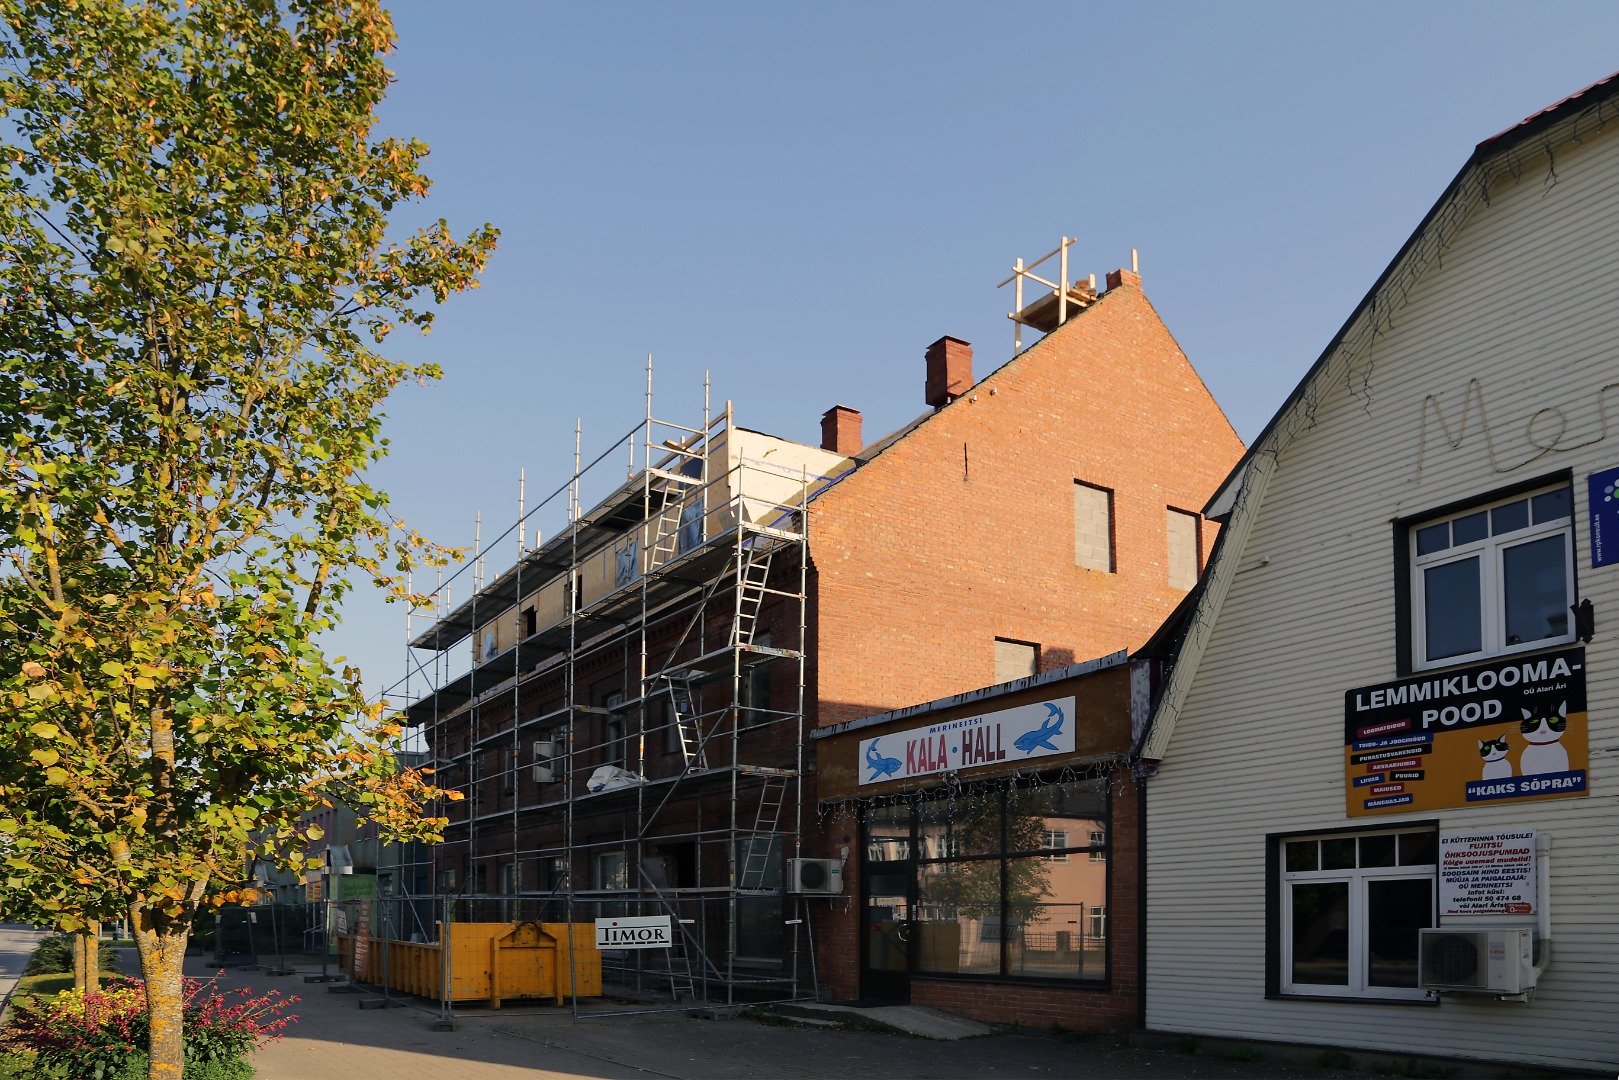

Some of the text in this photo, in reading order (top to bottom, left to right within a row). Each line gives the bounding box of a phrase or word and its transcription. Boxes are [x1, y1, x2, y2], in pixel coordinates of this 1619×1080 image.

[1356, 657, 1582, 712] LEMMIKLOOMA-
[1422, 699, 1503, 729] POOD
[929, 718, 983, 733] MERINEITSI
[1364, 722, 1405, 734] LOOMATOIDUD
[1389, 736, 1426, 745] JOOGINÕUD
[907, 724, 1005, 774] KALA HALL
[1360, 748, 1422, 761] PUHASTUSVAHENDID
[1373, 761, 1416, 770] AKVAARIUMID
[1360, 776, 1379, 784] LIIVAD
[1368, 797, 1409, 807] MÄNGUASJAD
[1445, 848, 1529, 858] ÕHKSOOJUSPUMBAD
